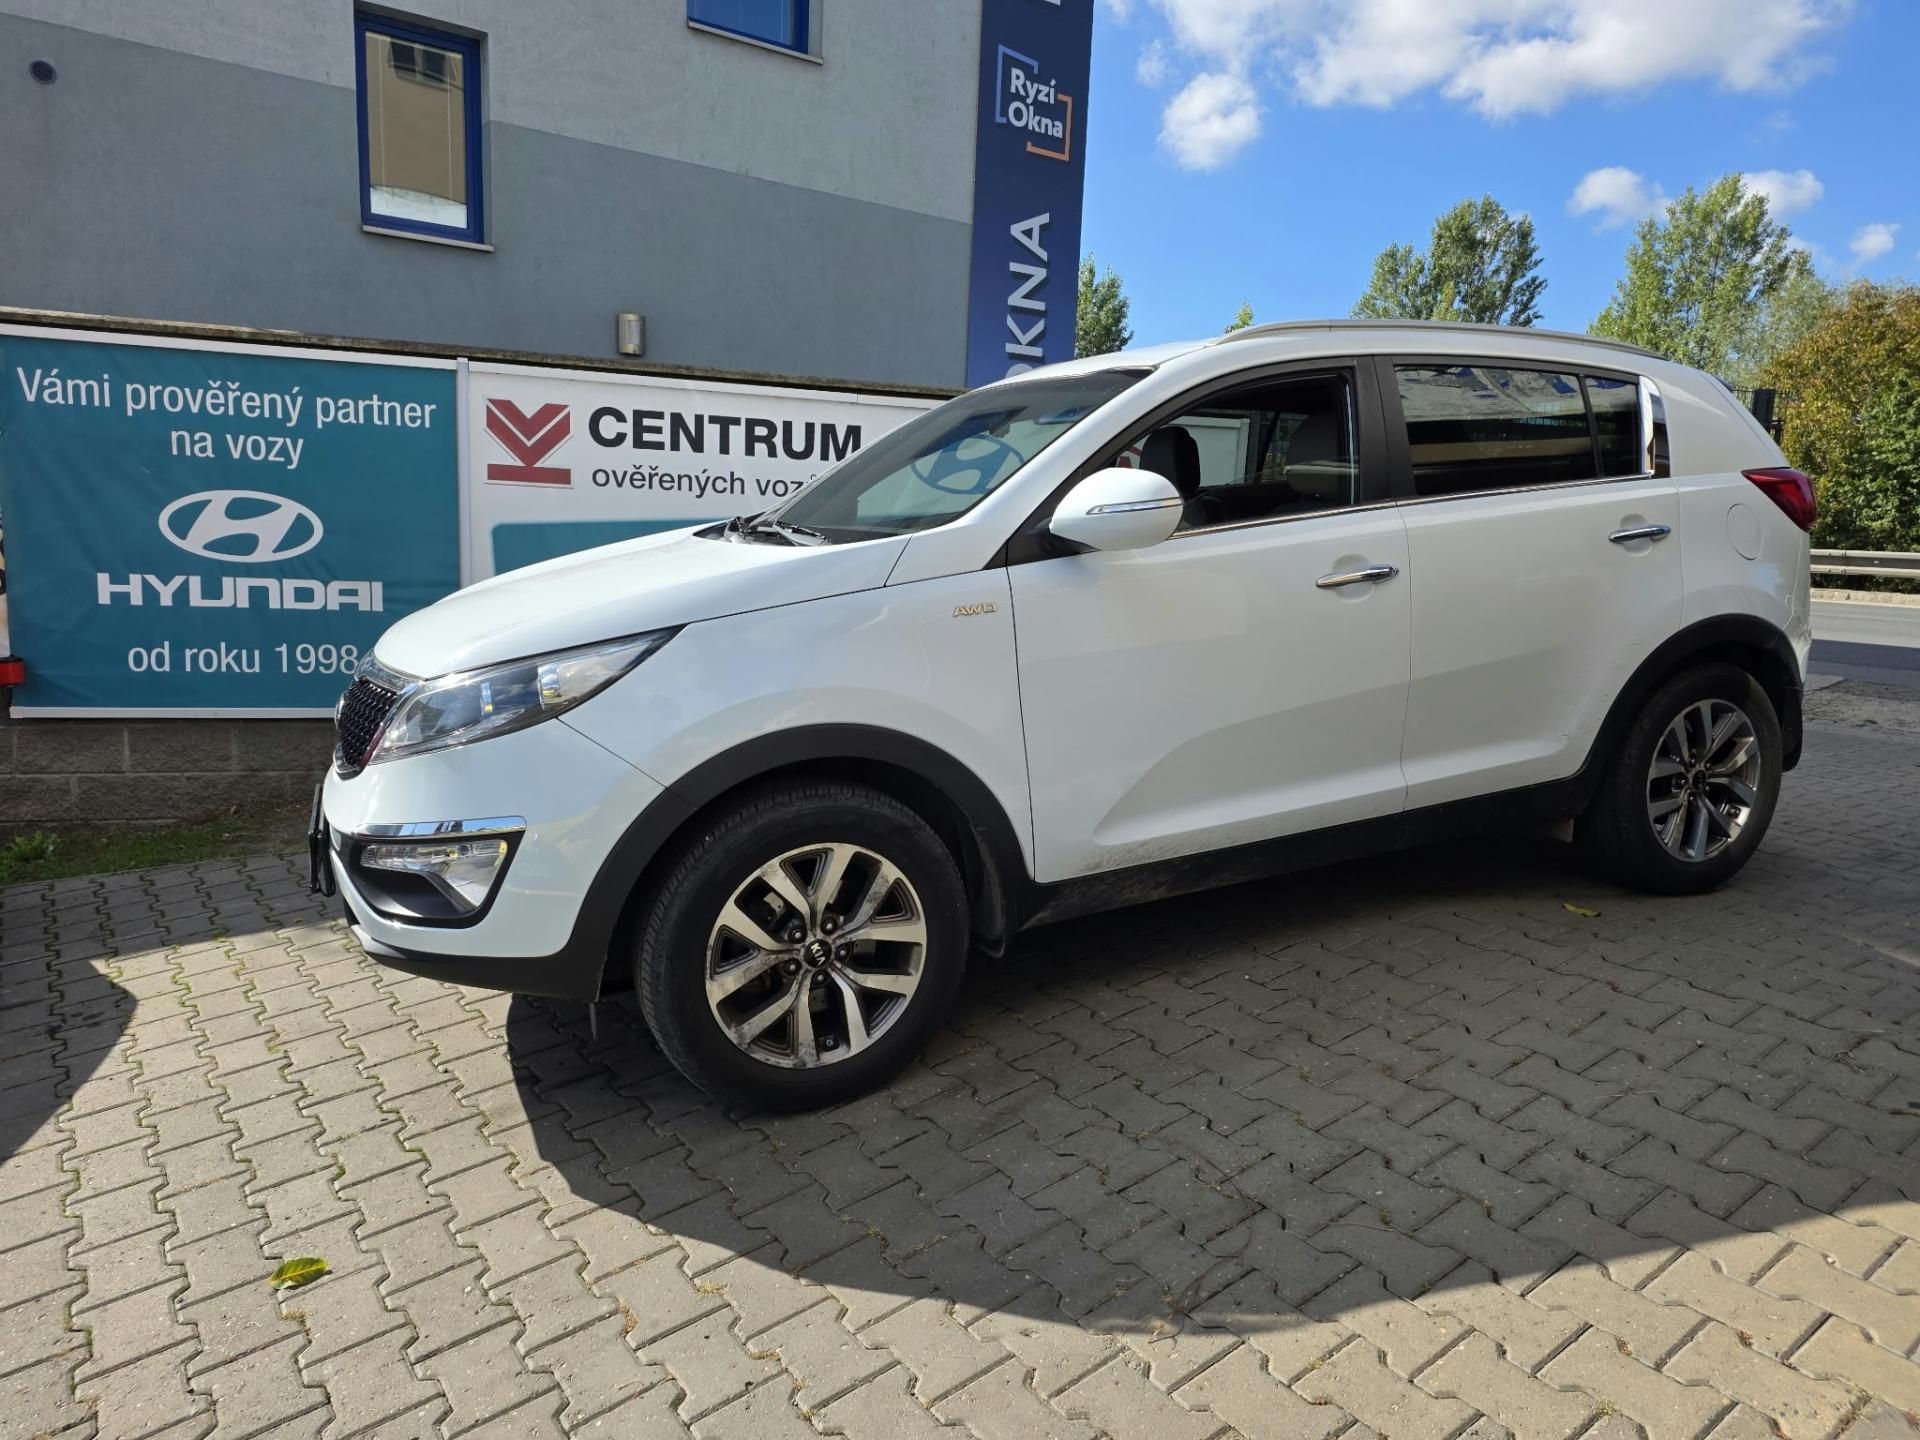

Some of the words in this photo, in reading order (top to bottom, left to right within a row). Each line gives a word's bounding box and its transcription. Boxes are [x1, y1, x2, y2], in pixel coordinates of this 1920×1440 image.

[1010, 66, 1057, 105] Ryzí
[1007, 100, 1063, 139] Okna
[17, 367, 110, 407] Vámi
[125, 380, 303, 427] prověřený
[316, 393, 437, 429] partner
[171, 429, 214, 459] na
[226, 433, 304, 469] vozy
[588, 406, 862, 462] CENTRUM
[592, 464, 745, 499] ověřených
[755, 473, 817, 498] voz
[97, 572, 384, 612] HYUNDAI
[952, 603, 997, 617] AWD
[128, 641, 170, 673] od
[185, 641, 260, 673] roku
[275, 643, 359, 674] 1998
